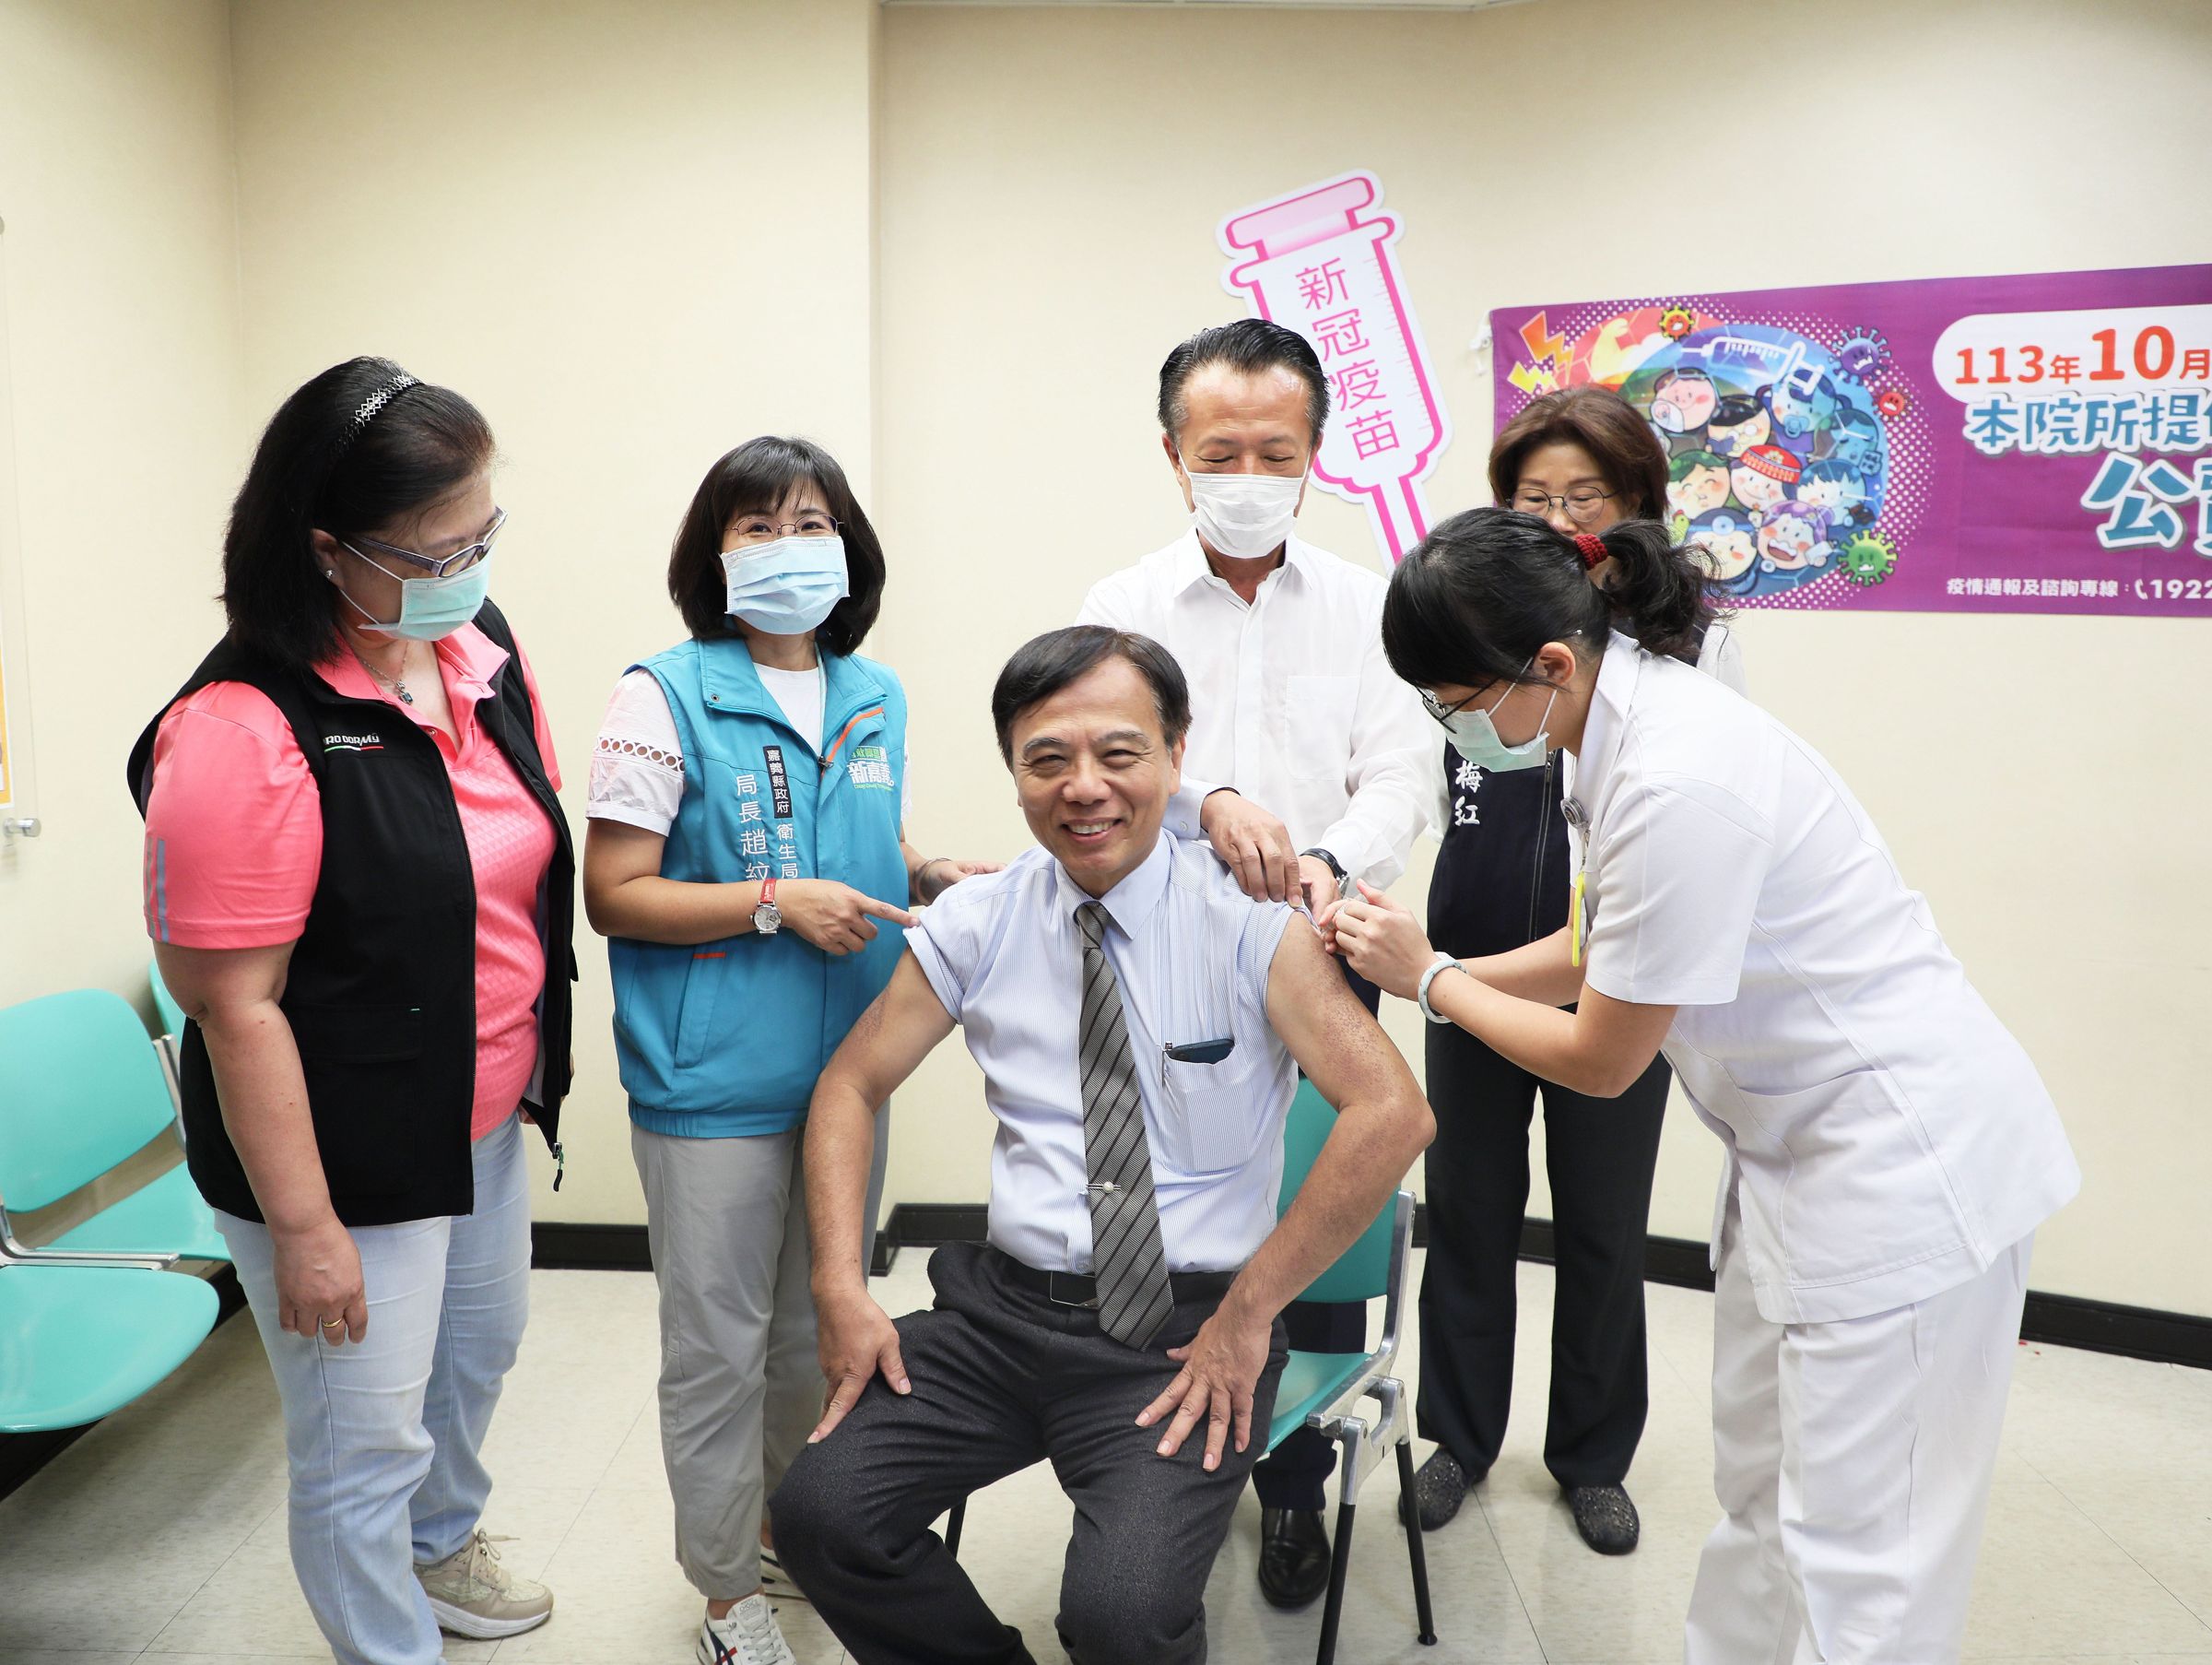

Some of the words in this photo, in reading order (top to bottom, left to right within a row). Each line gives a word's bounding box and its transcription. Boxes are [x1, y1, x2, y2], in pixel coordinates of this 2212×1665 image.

[1295, 257, 1401, 461] 新冠疫苗
[1955, 325, 2210, 384] 113年10月
[1970, 394, 2212, 447] 本院所提
[2086, 457, 2212, 550] 公
[766, 749, 790, 814] 嘉義縣政府
[776, 823, 799, 880] 衛生局
